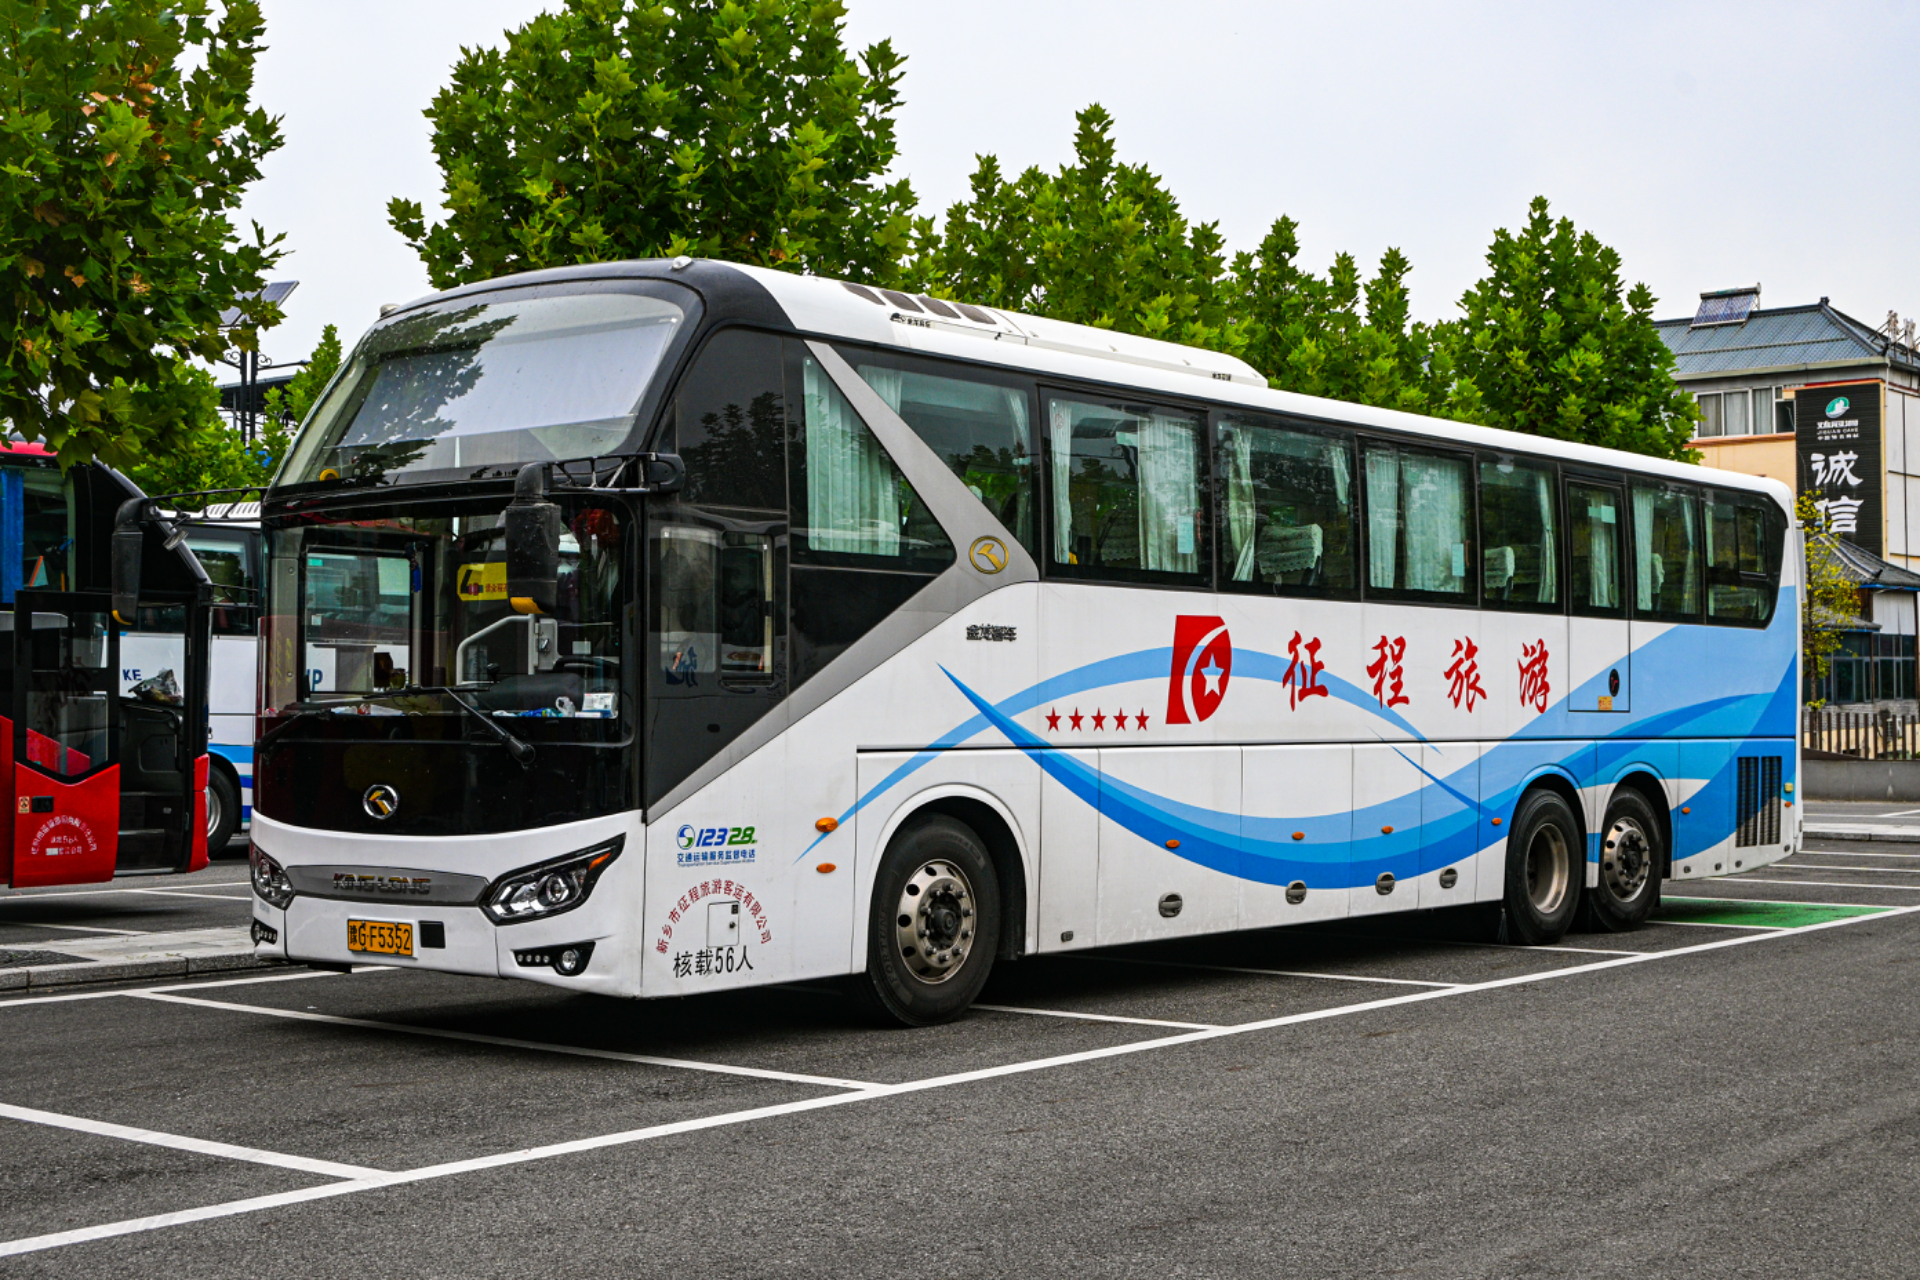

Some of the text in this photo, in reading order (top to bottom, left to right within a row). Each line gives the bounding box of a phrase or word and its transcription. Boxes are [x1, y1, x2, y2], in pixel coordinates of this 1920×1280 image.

[1810, 450, 1864, 533] 诚信
[1282, 630, 1550, 714] 征程旅游
[696, 826, 755, 847] 12328
[677, 848, 755, 862] 交通运输服务监督电话
[333, 873, 431, 895] KING LONG
[656, 878, 772, 955] 新乡市征程旅游客运有限公司
[673, 945, 754, 978] 核载56人
